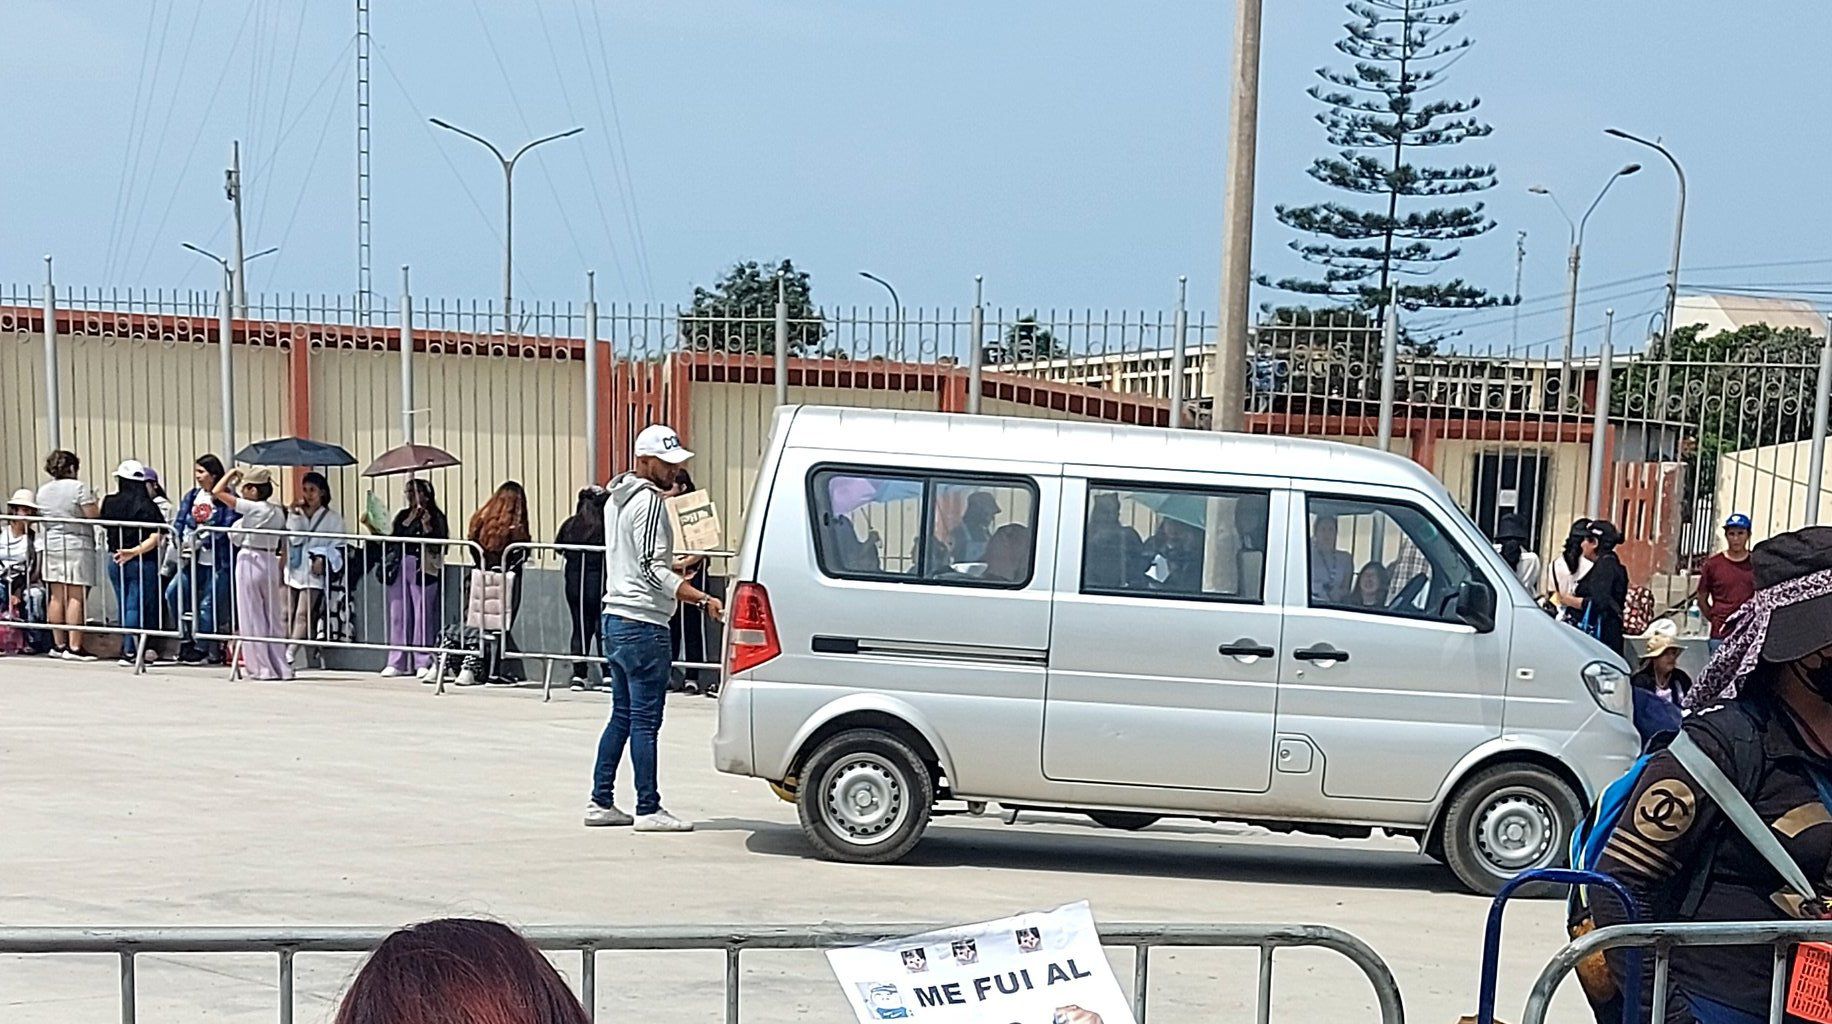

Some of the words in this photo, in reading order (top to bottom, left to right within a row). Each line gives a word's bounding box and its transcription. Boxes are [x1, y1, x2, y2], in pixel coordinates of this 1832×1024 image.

[913, 982, 966, 1007] ME
[973, 968, 1034, 1001] FUI
[1047, 959, 1091, 986] AL
